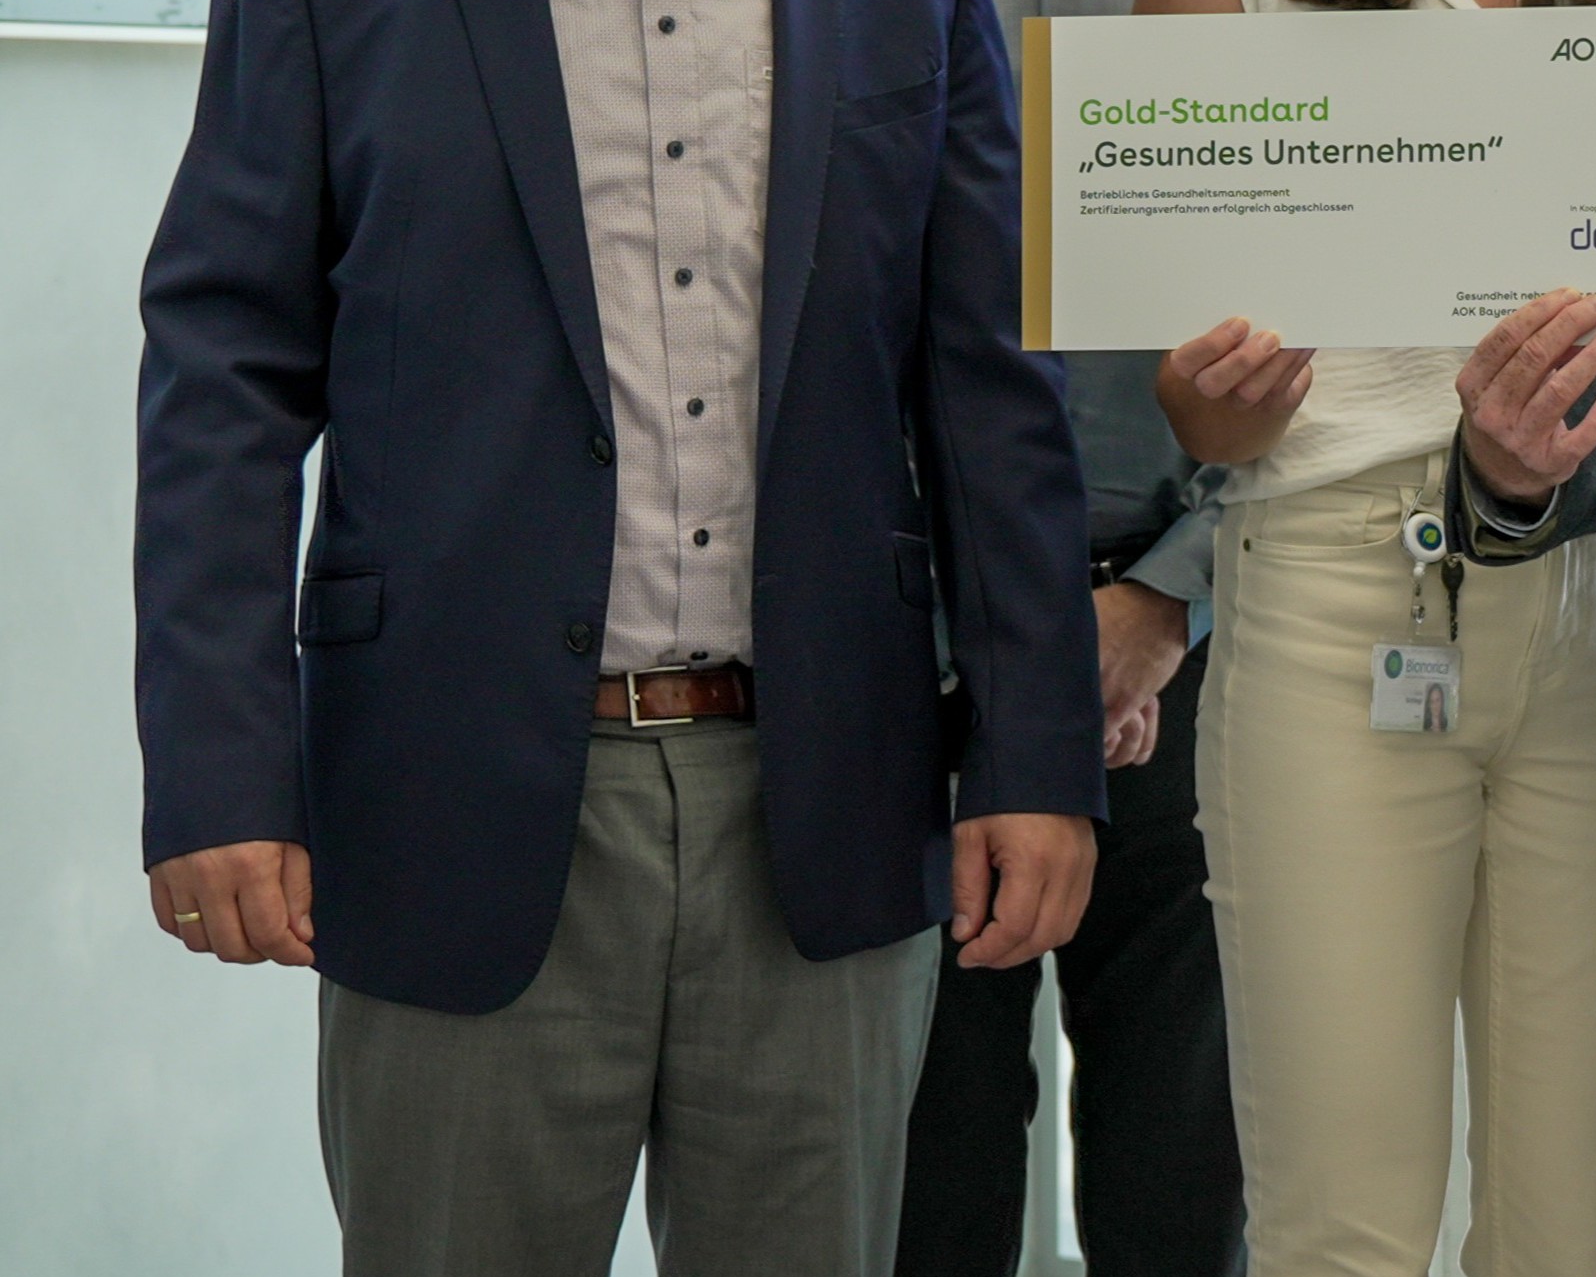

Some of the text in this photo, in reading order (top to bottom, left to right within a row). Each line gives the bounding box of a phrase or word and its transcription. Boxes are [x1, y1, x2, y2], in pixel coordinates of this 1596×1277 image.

[1079, 96, 1329, 125] Gold-Standard
[1079, 135, 1503, 173] „Gesundes Unternehmen“
[1080, 188, 1291, 201] Betriebliches Gesundheitsmanagement
[1080, 202, 1354, 216] Zertifizierungsverfahren erfolgreich abgeschlossen
[1456, 291, 1518, 301] Gesundheit
[1452, 307, 1476, 316] AOK
